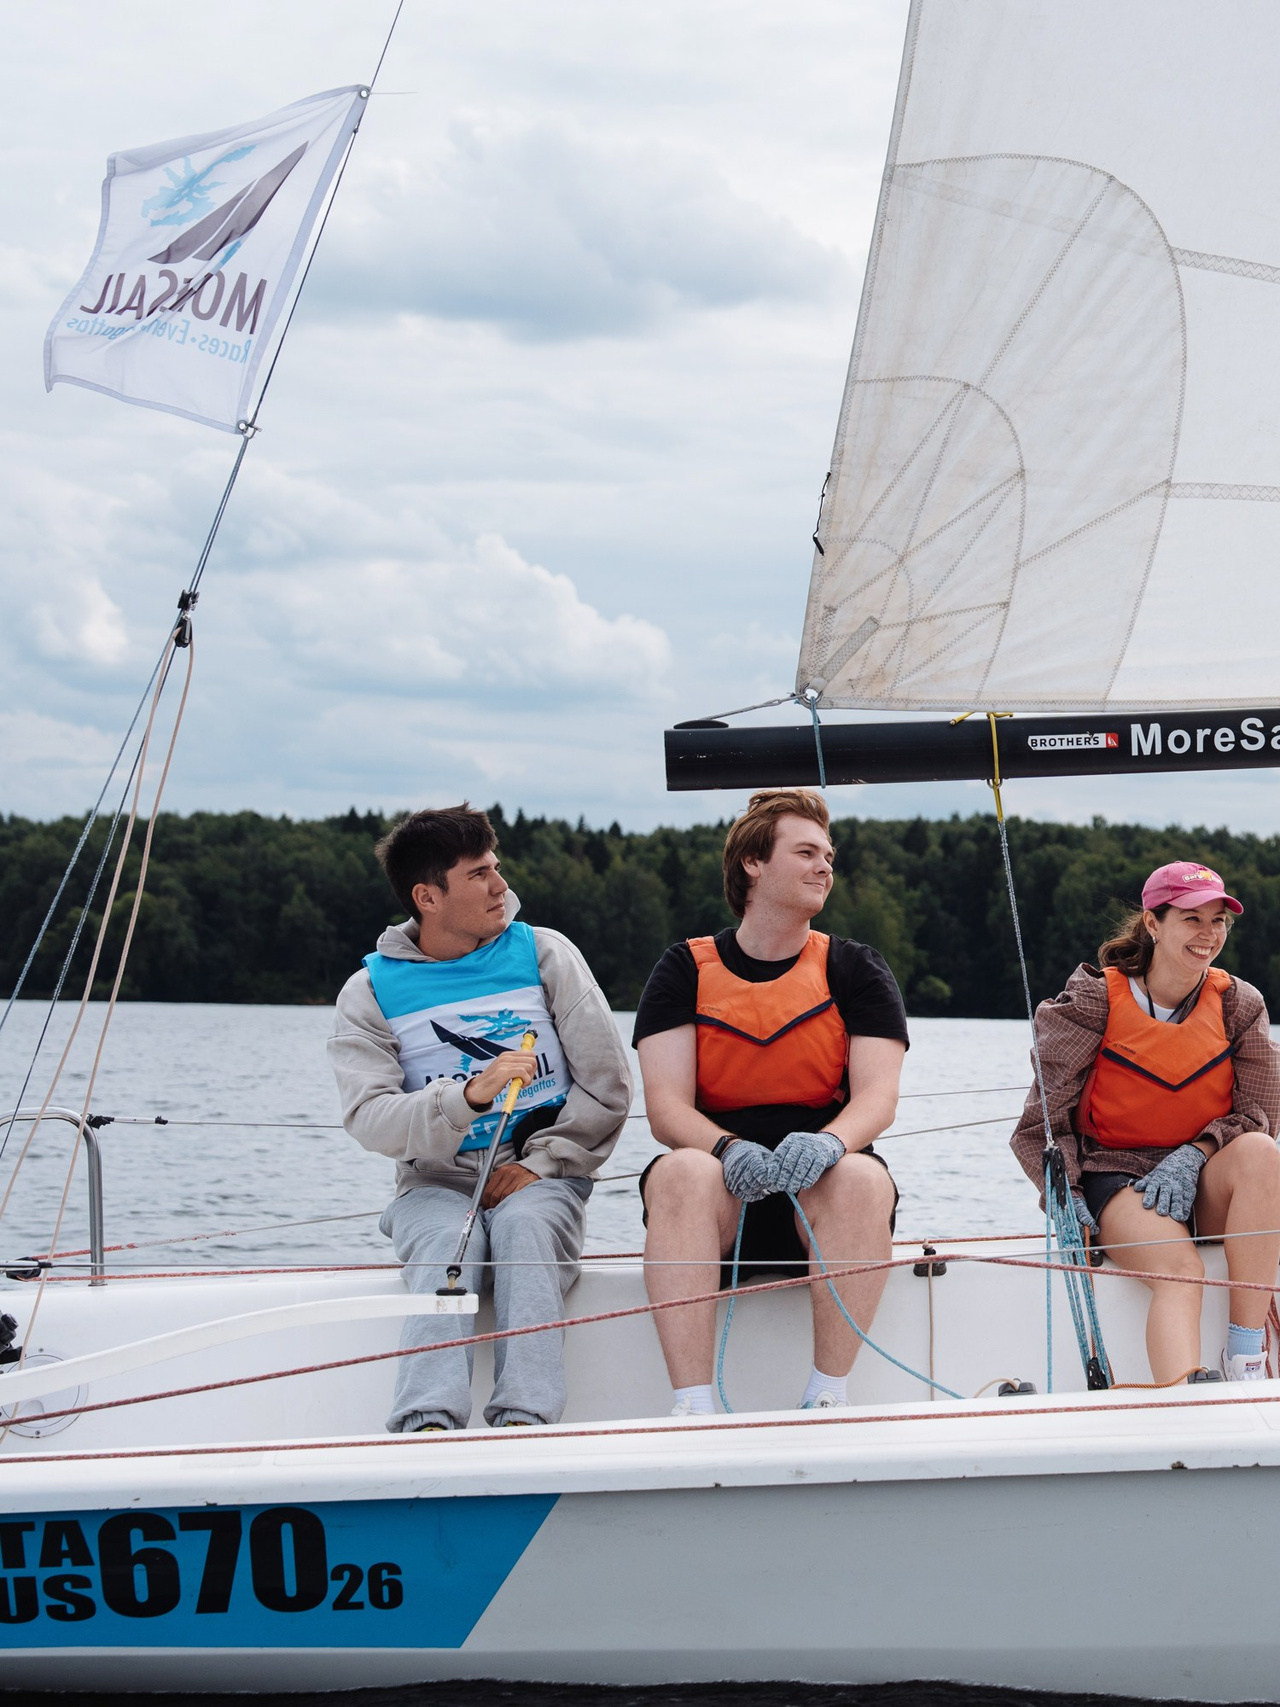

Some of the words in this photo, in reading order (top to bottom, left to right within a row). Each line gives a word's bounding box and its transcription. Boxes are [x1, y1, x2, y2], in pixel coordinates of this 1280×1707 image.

[1030, 736, 1100, 748] BROTHERS
[97, 1507, 328, 1618] 670
[330, 1562, 403, 1611] 26
